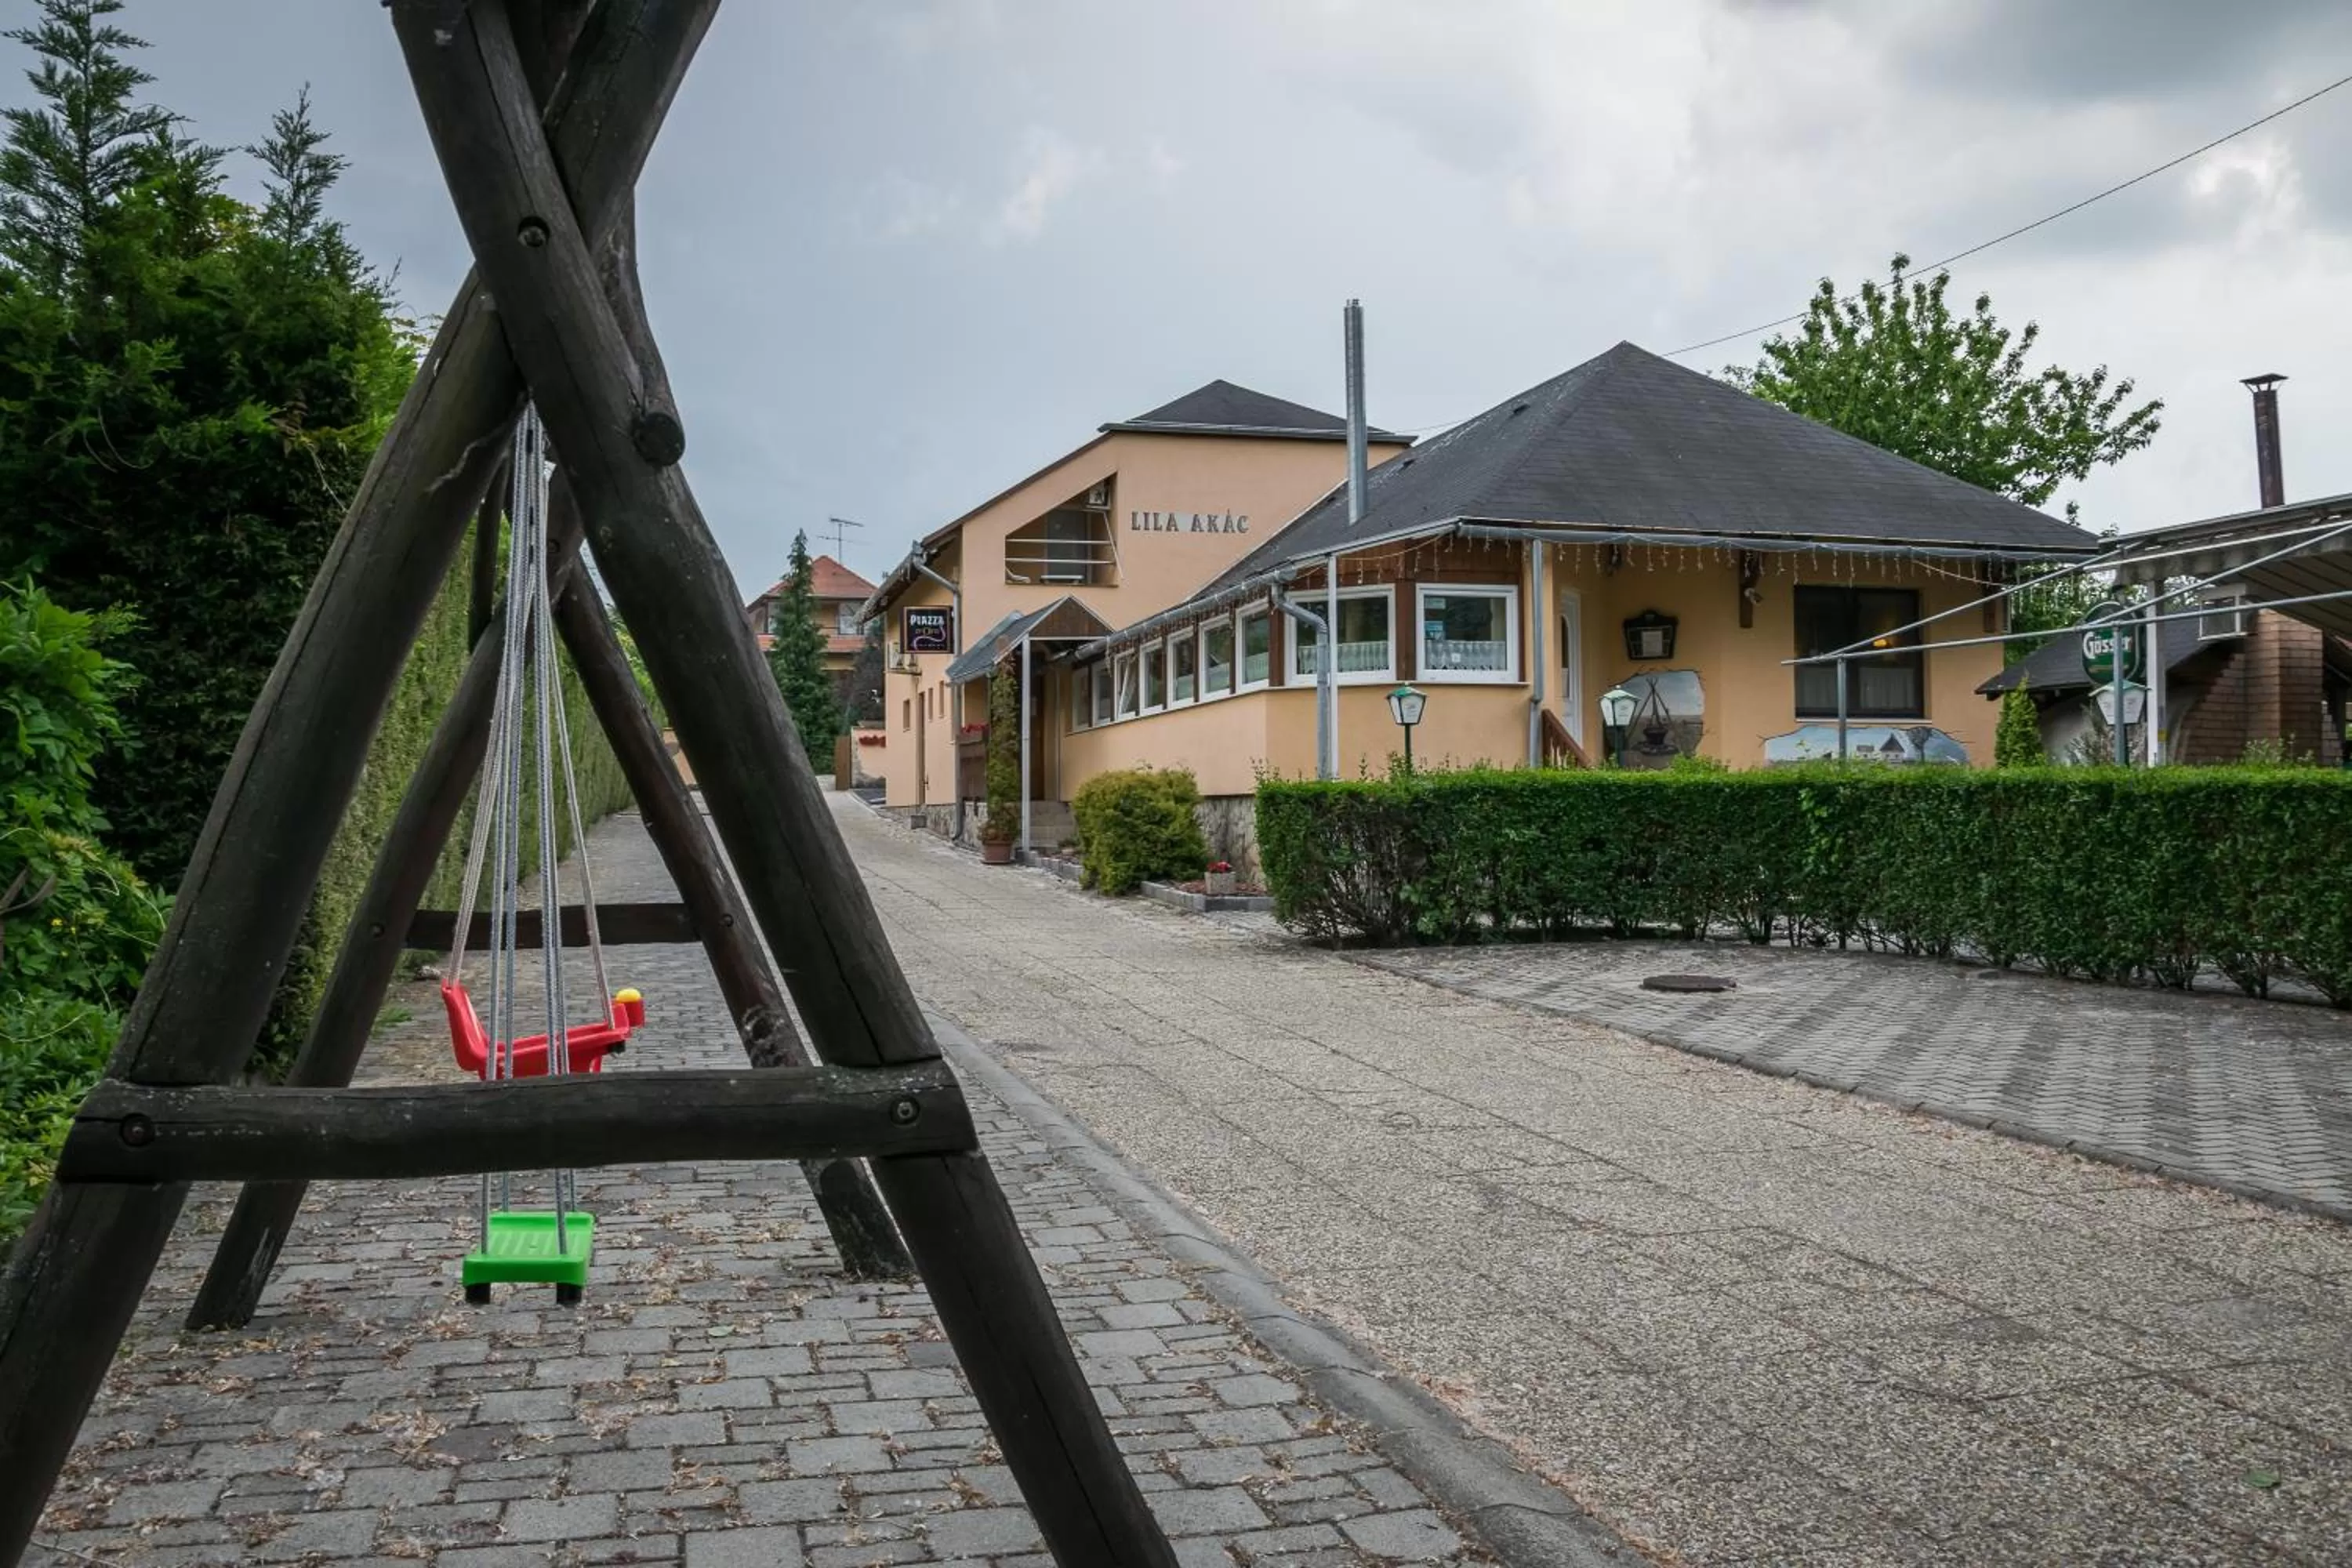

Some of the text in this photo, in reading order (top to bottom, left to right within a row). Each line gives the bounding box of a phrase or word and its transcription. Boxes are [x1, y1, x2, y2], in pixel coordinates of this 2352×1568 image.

[1131, 508, 1249, 534] LILA AKÁC
[910, 614, 945, 626] PIAZZA
[2083, 631, 2132, 659] Gössr
